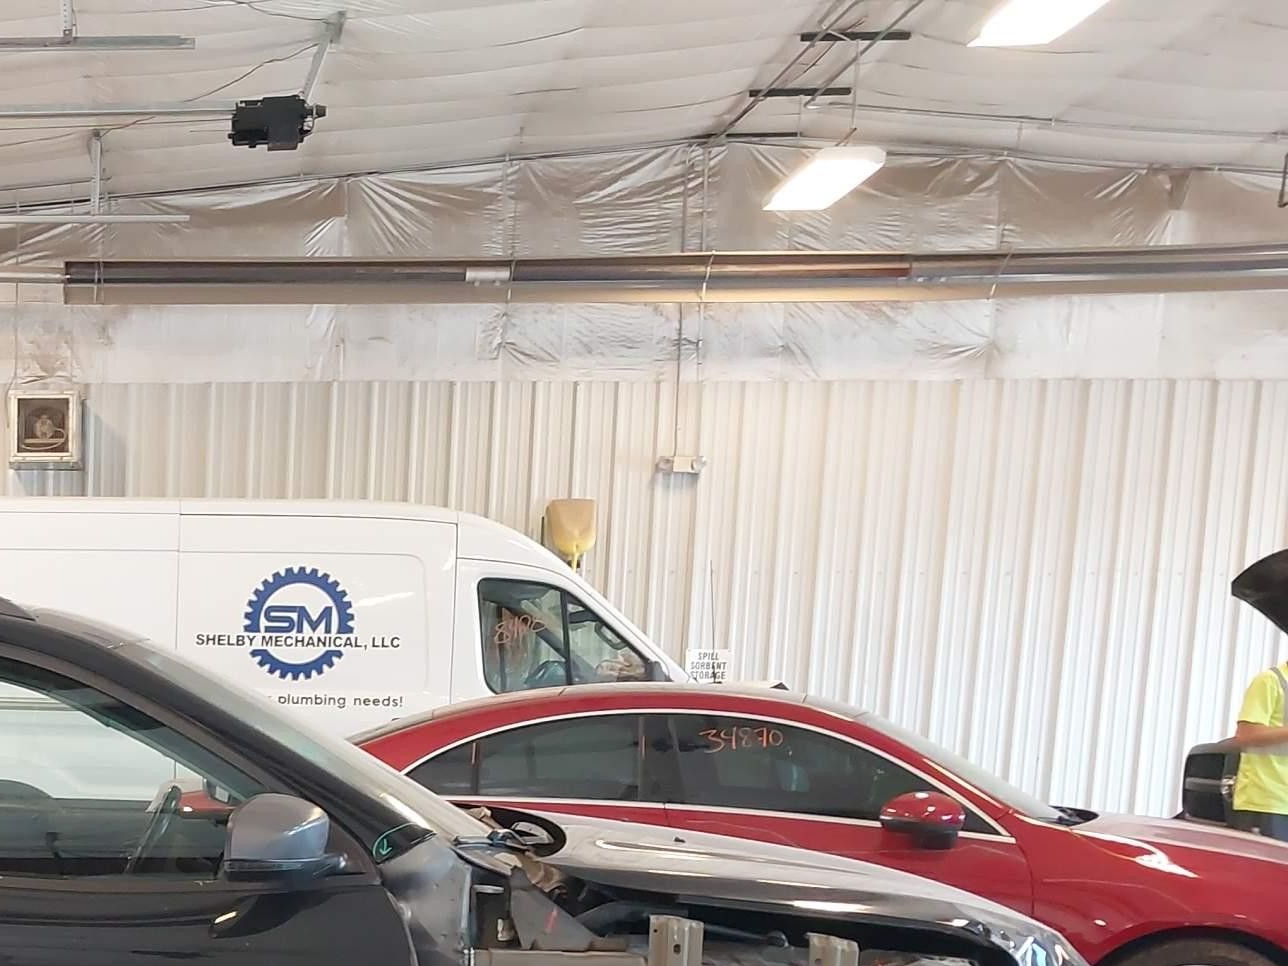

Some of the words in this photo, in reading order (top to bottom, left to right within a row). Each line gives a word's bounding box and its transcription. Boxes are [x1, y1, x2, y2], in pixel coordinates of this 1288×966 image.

[263, 605, 333, 634] SM
[196, 633, 256, 647] SHELBY
[261, 635, 367, 650] MECHANICAL,
[372, 636, 400, 648] LLC
[698, 652, 719, 660] SPILL
[691, 661, 727, 670] SORBENT
[690, 671, 726, 680] STORAGE
[353, 696, 403, 707] needs!
